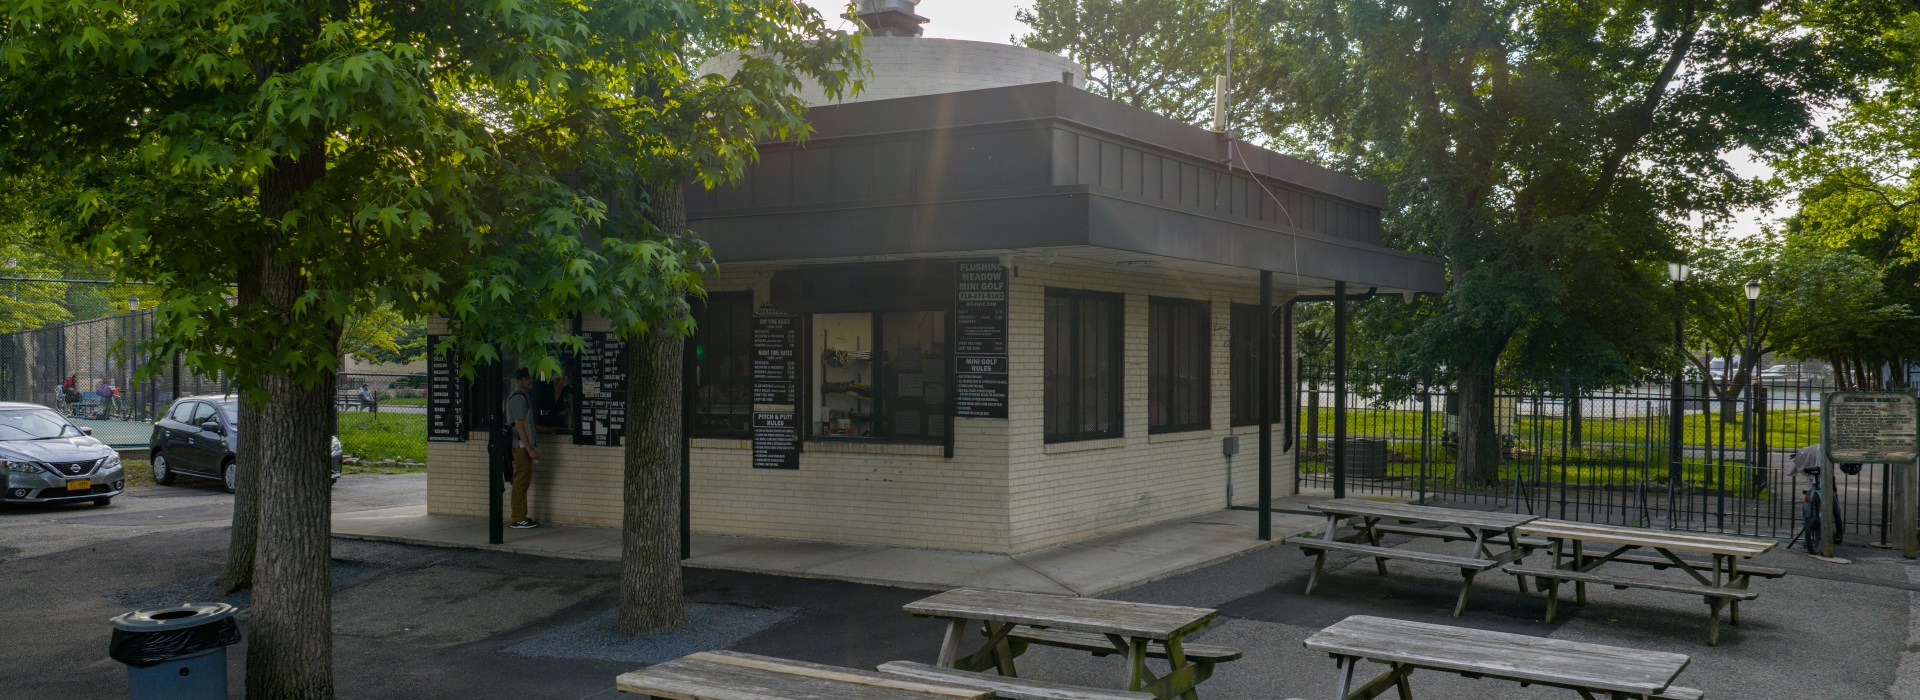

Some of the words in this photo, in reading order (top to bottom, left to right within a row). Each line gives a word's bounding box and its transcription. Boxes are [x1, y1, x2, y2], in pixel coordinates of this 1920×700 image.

[962, 273, 1002, 281] MEADOW
[959, 282, 979, 290] MINI
[981, 282, 1004, 290] GOLF
